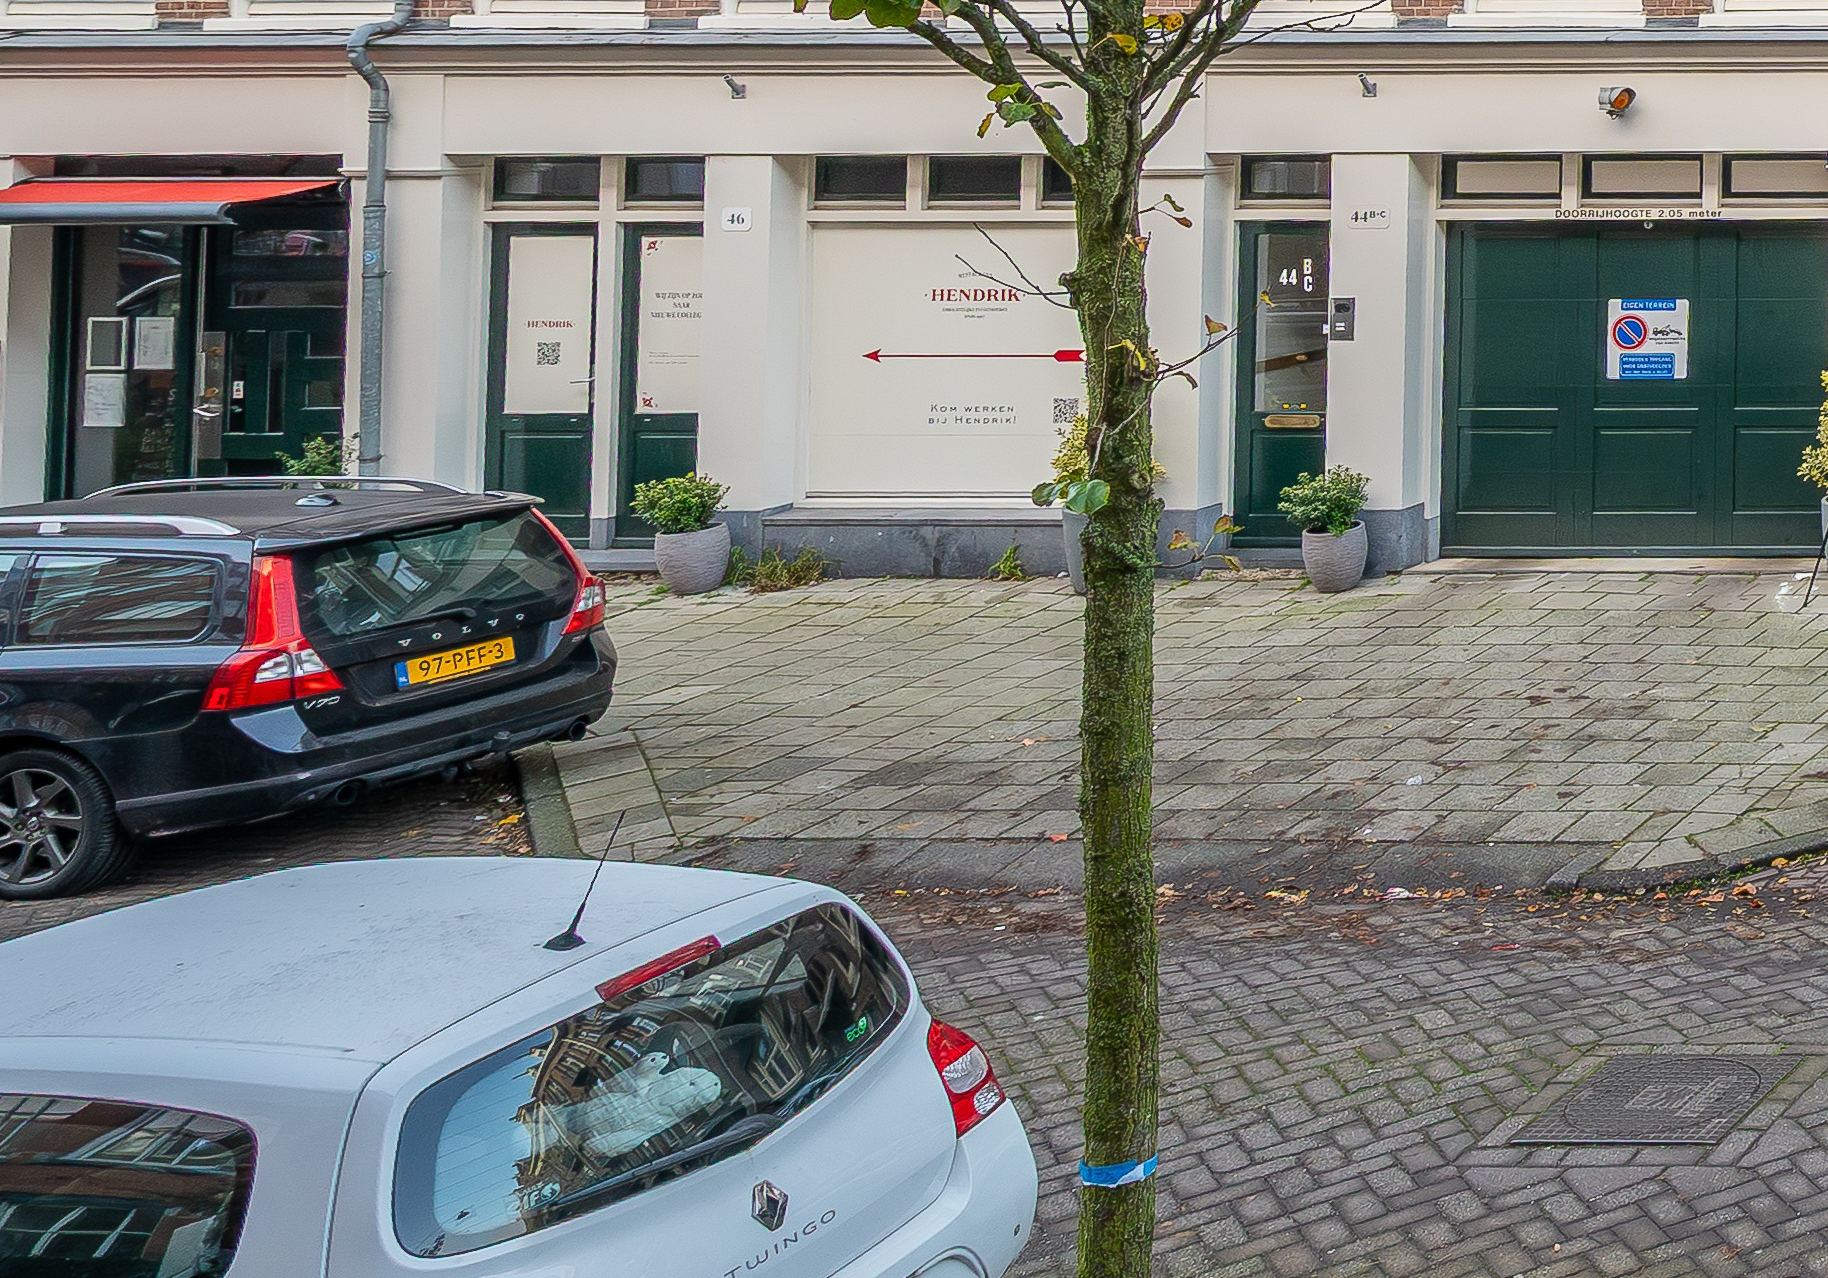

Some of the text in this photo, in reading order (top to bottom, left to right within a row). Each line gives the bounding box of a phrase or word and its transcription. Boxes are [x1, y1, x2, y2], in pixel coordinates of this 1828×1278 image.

[726, 212, 745, 225] 46
[1555, 209, 1723, 218] DOORRIJHOOGTE 2.05 meter
[1279, 258, 1312, 286] 44 B
[1303, 275, 1313, 292] C
[931, 288, 1021, 302] HENDRIK
[526, 320, 574, 328] HENDRIK
[398, 612, 525, 647] VOLVO
[418, 642, 505, 677] 97-PFF-3
[723, 1209, 836, 1278] TWINGO
